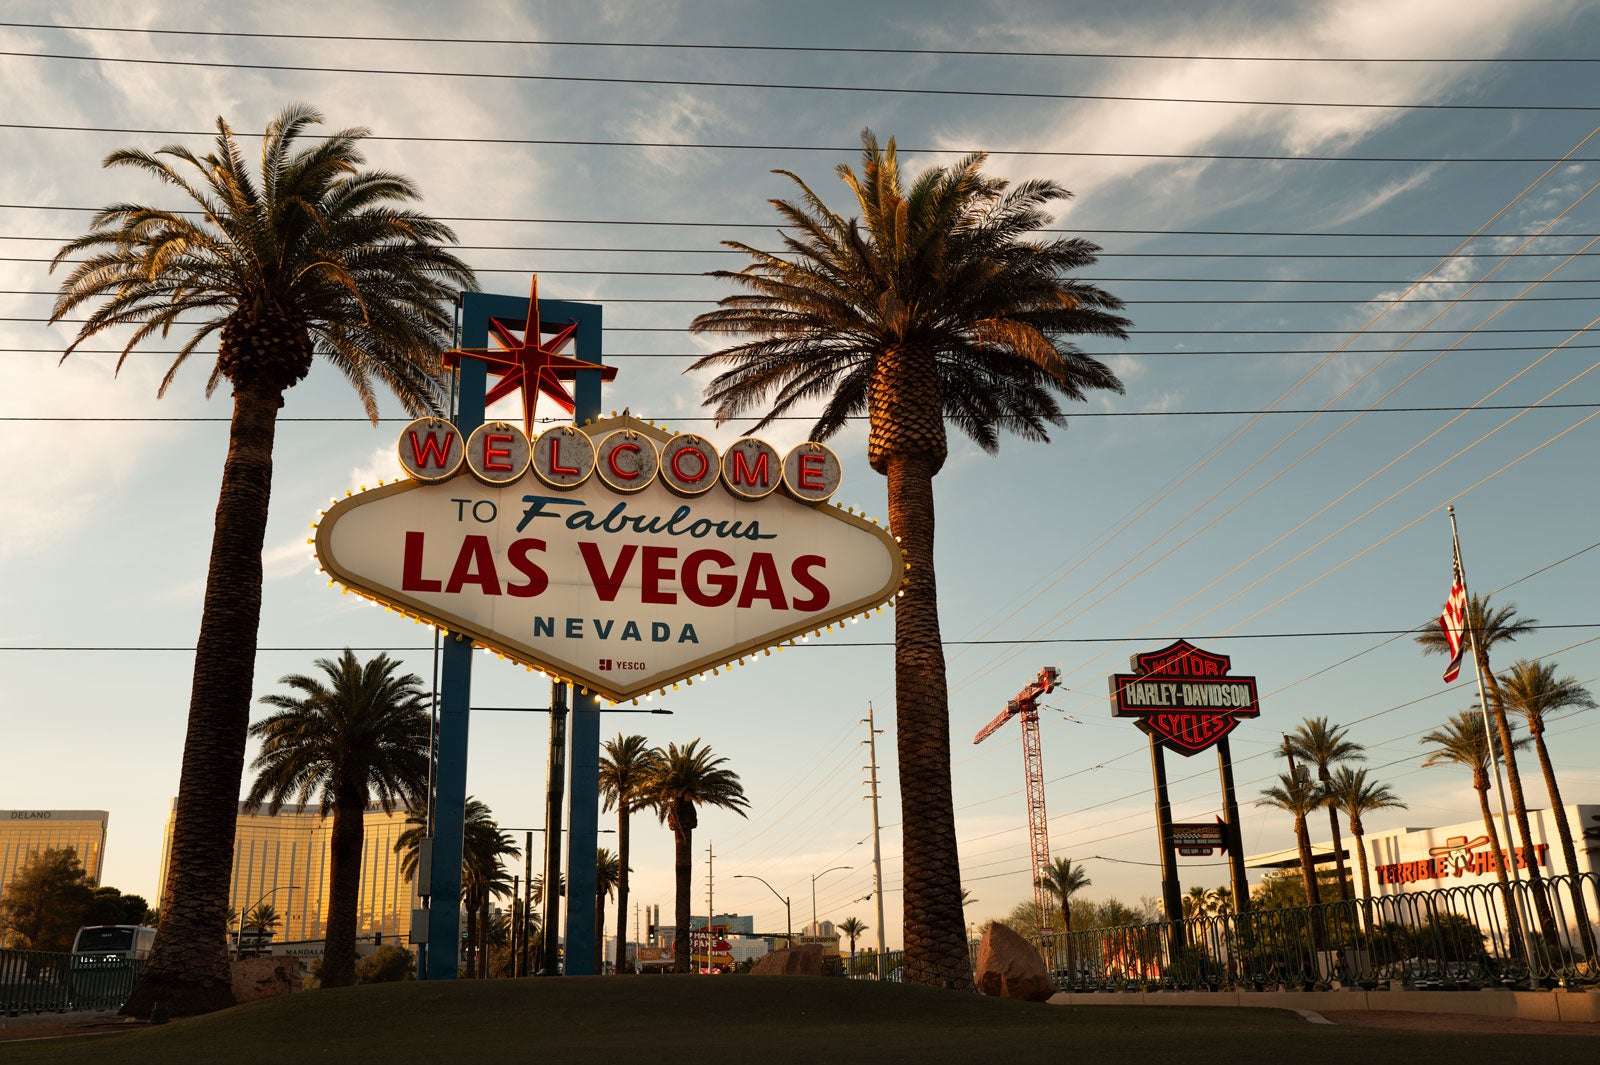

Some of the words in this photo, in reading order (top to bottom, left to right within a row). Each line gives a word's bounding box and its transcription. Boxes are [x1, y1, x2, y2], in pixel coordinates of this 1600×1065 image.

[409, 431, 825, 490] WELCOME
[451, 498, 498, 523] TO
[516, 495, 777, 541] Fabulous
[402, 531, 549, 597] LAS
[577, 542, 830, 612] VEGAS
[533, 616, 699, 644] NEVADA
[616, 661, 646, 671] YESCO
[1153, 650, 1219, 676] MOTOR
[1126, 682, 1251, 707] HARLEY-DAVIDSON
[1158, 714, 1224, 743] CYCLES
[11, 811, 51, 819] DELANO
[1375, 857, 1449, 885] TERRIBLE
[1475, 844, 1549, 877] HERBT
